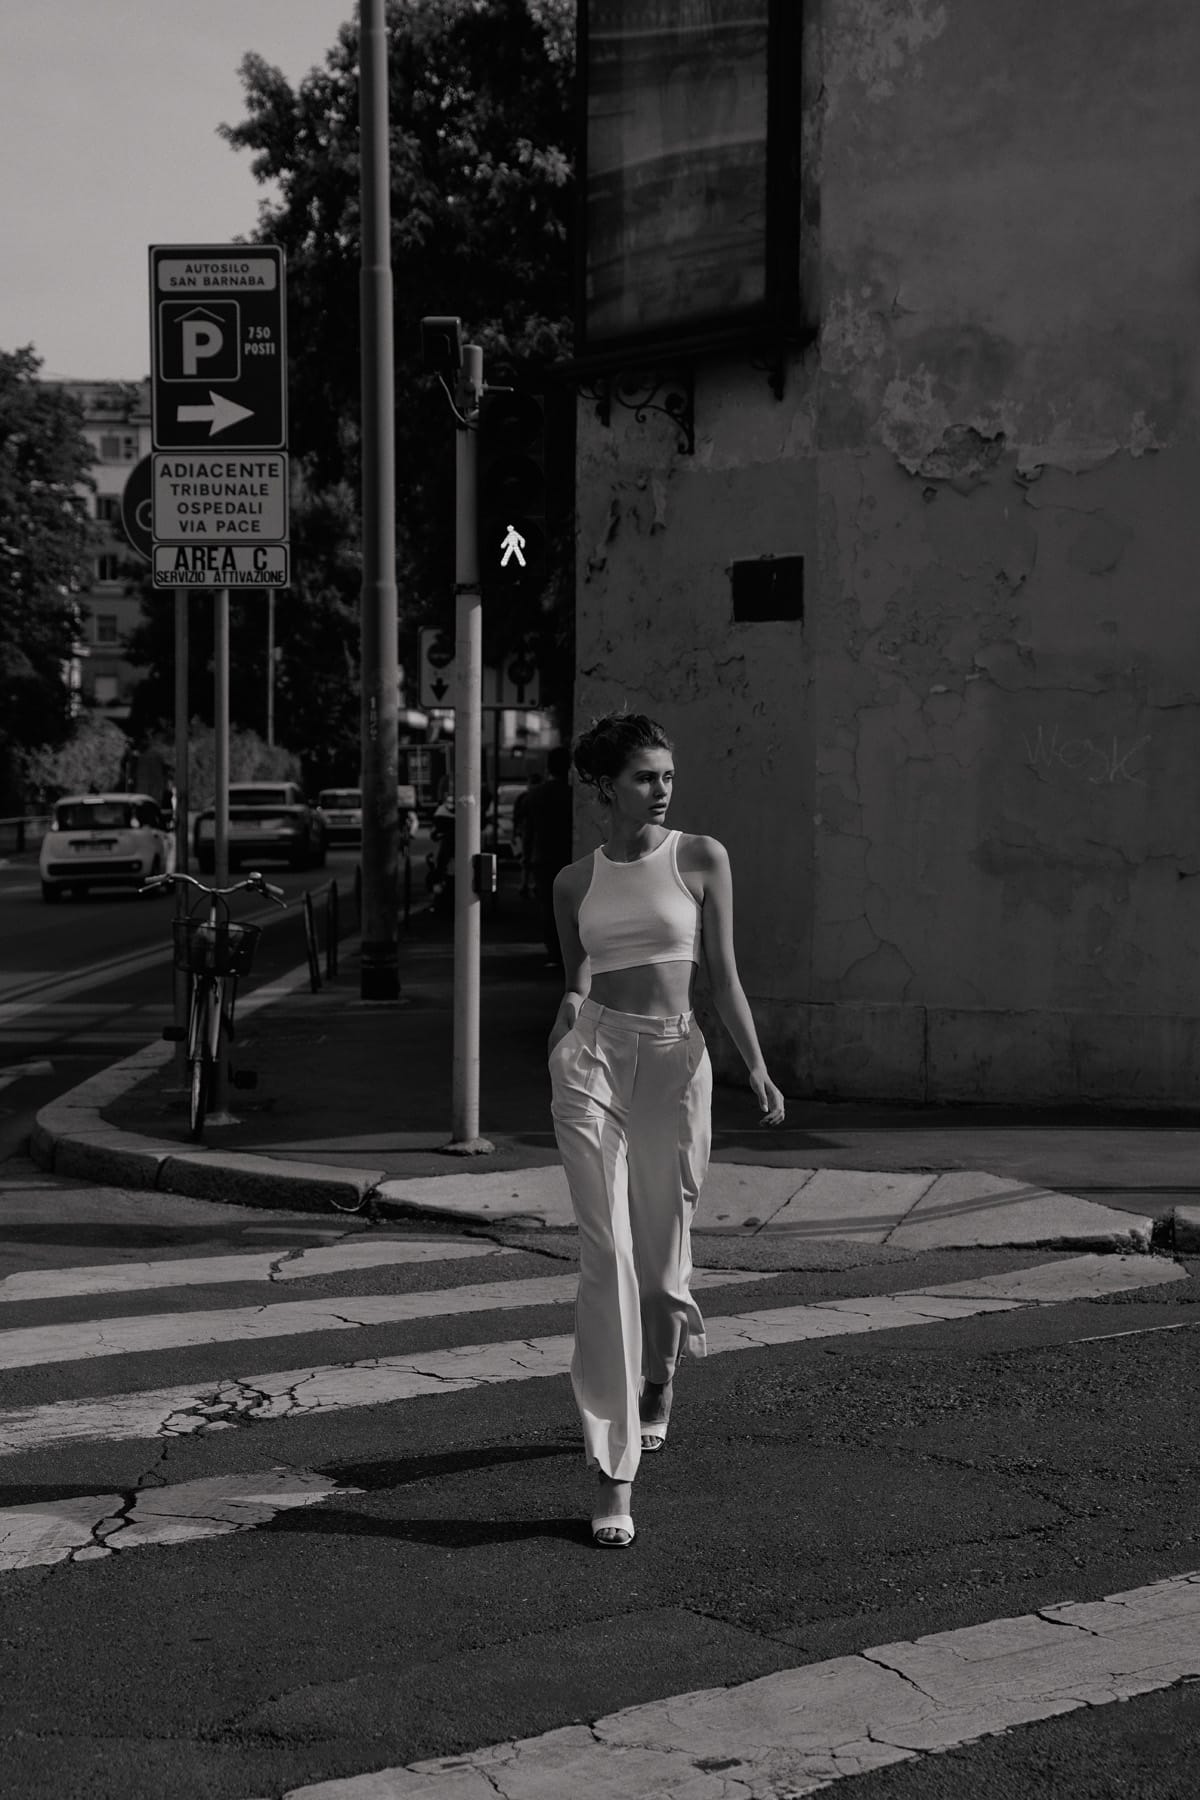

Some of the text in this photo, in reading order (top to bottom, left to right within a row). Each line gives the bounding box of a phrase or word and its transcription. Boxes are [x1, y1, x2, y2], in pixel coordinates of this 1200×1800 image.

[185, 264, 249, 274] AUTOSILO
[170, 276, 265, 287] SAN BARNABA
[248, 326, 271, 340] 750
[182, 320, 223, 375] P
[244, 342, 275, 355] POSTI
[161, 463, 279, 478] ADIACENTE
[170, 484, 270, 497] TRIBUNALE
[177, 502, 262, 515] OSPEDALI
[179, 520, 261, 533] VIA PACE
[174, 547, 267, 571] AREA C
[156, 570, 285, 583] SERVIZIO ATTIVAZIONE
